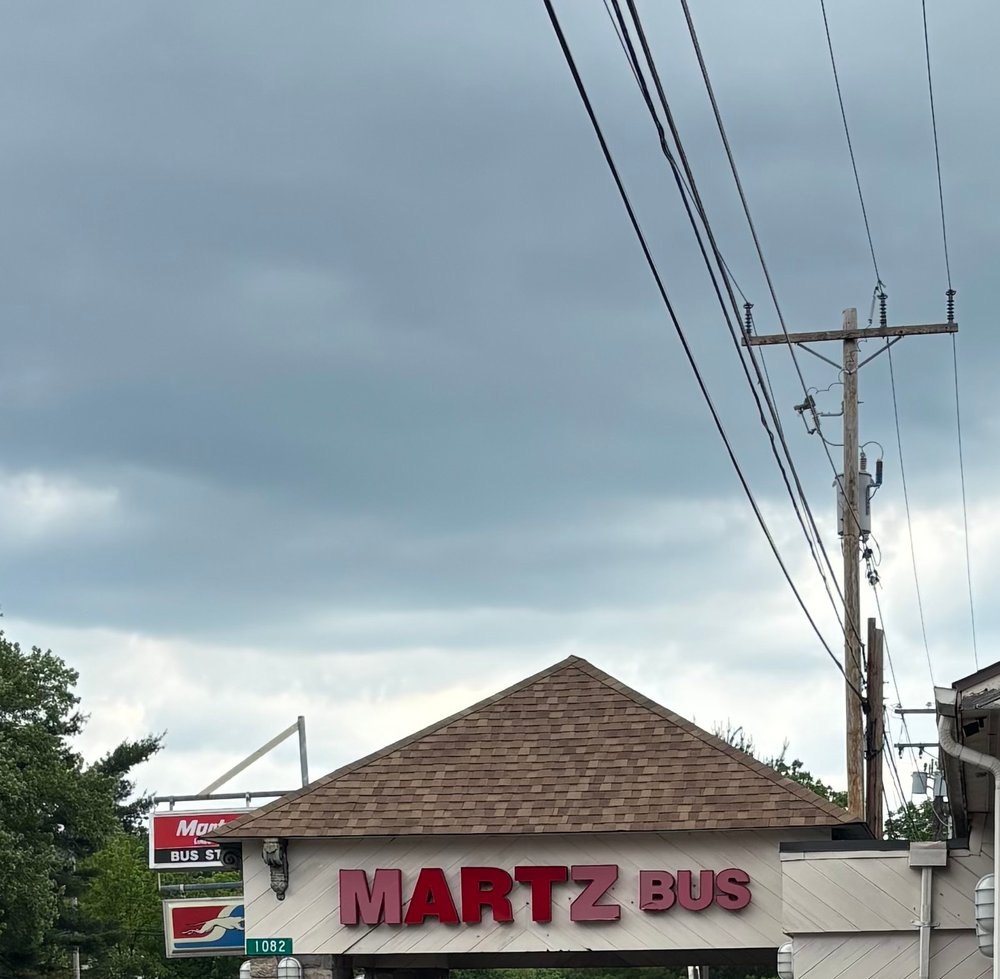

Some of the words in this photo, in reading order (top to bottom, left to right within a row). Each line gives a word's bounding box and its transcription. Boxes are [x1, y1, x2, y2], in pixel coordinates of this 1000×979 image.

[170, 850, 199, 861] BUS
[205, 849, 221, 860] ST
[339, 865, 621, 925] MARTZ
[639, 868, 752, 911] BUS
[255, 940, 286, 953] 1082
